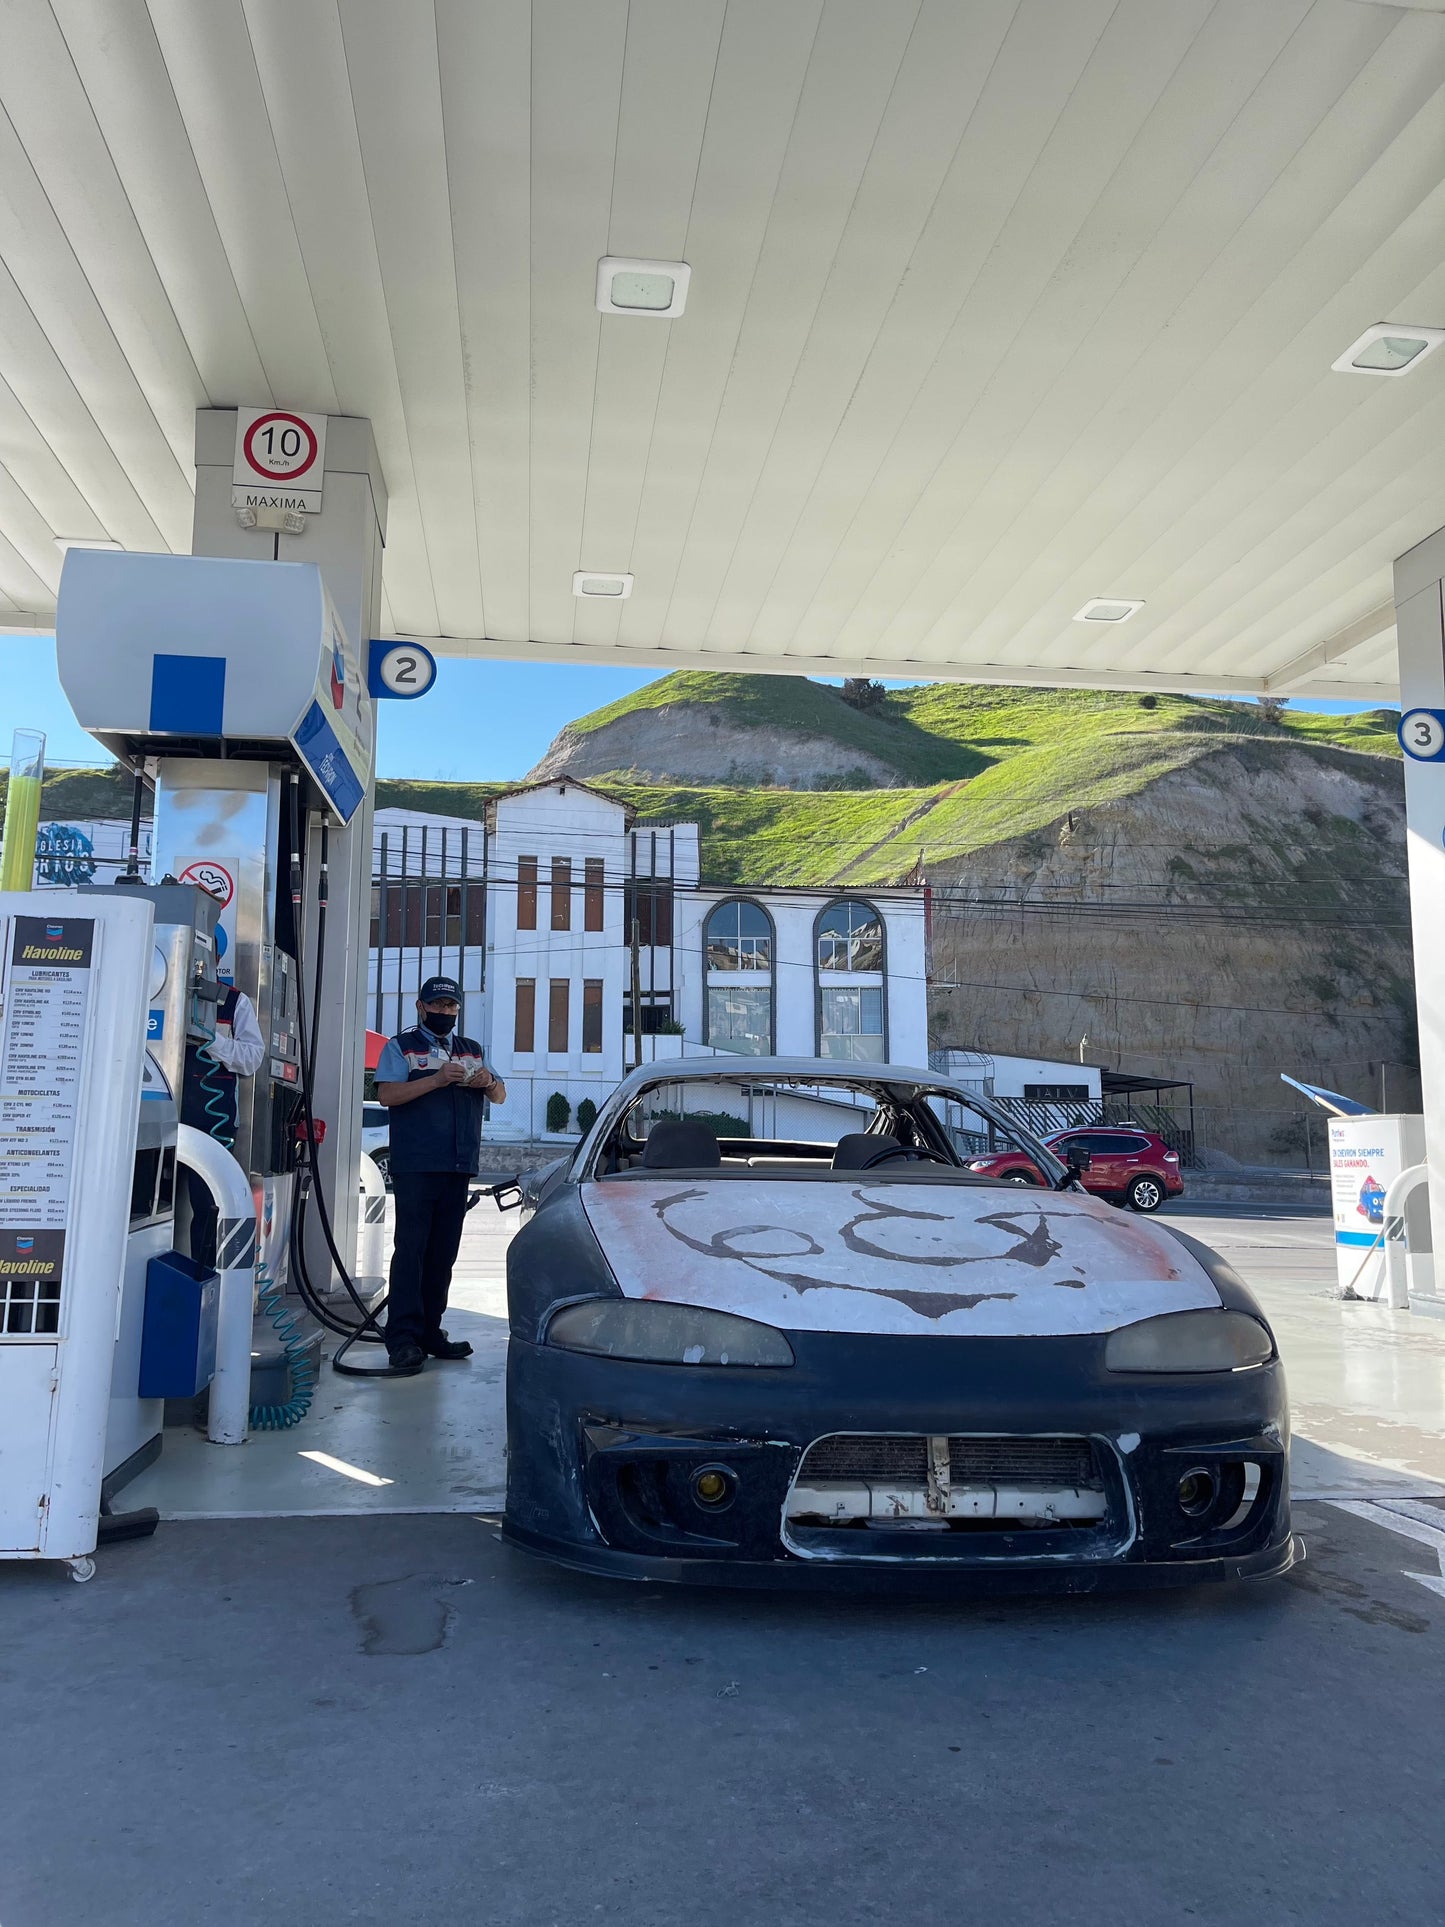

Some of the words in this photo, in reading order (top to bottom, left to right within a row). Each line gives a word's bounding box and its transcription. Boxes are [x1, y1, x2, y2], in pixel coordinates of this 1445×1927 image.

[261, 427, 301, 457] 10
[246, 495, 307, 509] MAXIMA
[395, 657, 417, 683] 2
[1414, 722, 1432, 746] 3
[35, 839, 83, 853] IGLESIA
[22, 945, 84, 961] Havoline
[31, 970, 70, 978] LUBRICANTES
[18, 1089, 61, 1097] MOTOCICLETAS
[16, 1125, 56, 1133] TRANSMISIÓN
[1358, 1148, 1385, 1157] SIEMPRE
